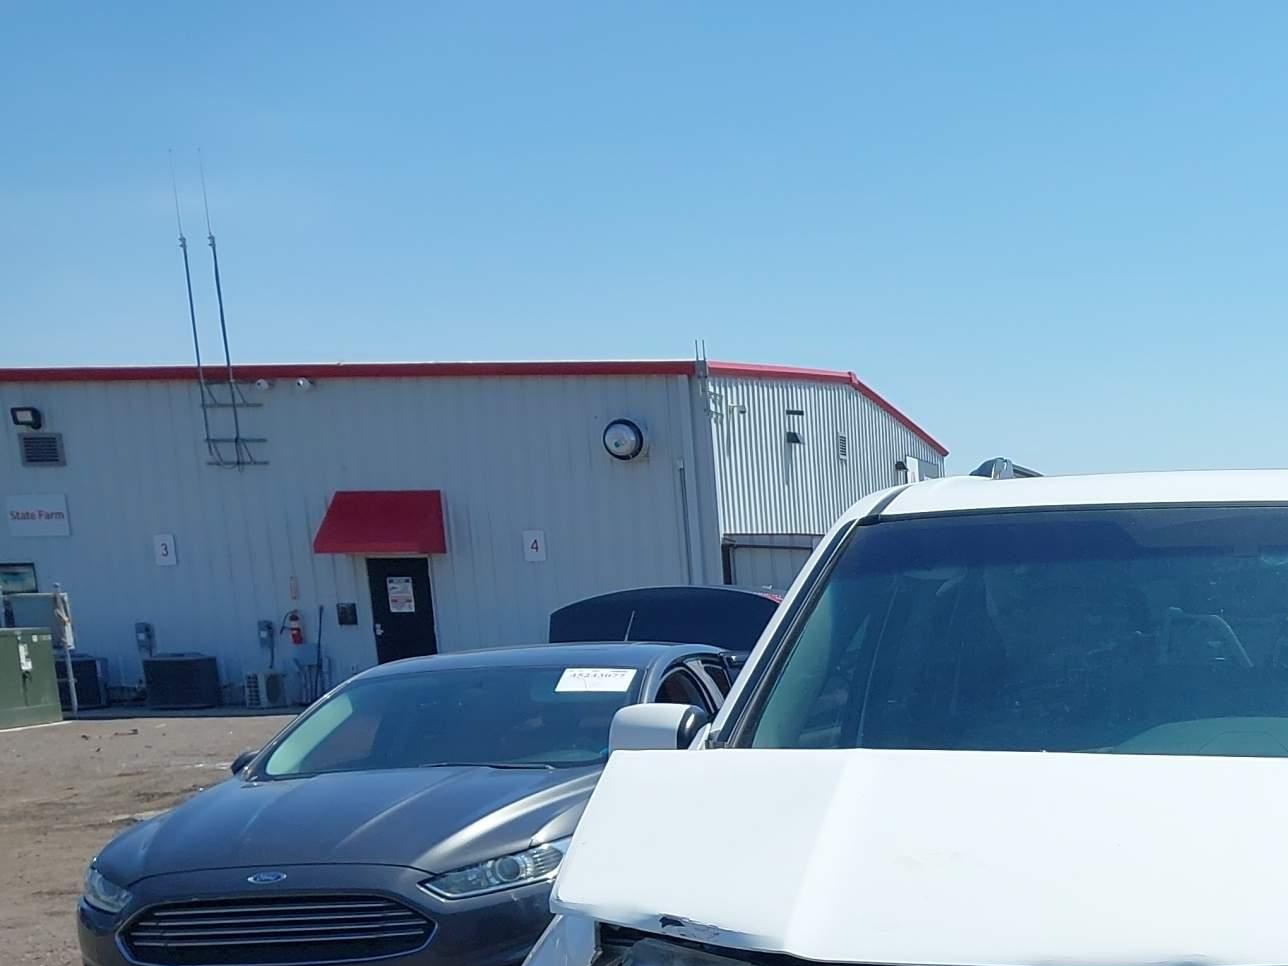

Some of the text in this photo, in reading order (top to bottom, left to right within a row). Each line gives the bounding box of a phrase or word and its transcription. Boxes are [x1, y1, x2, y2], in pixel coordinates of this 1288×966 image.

[10, 509, 65, 520] State Farm
[160, 543, 169, 557] 3
[530, 539, 539, 552] 4
